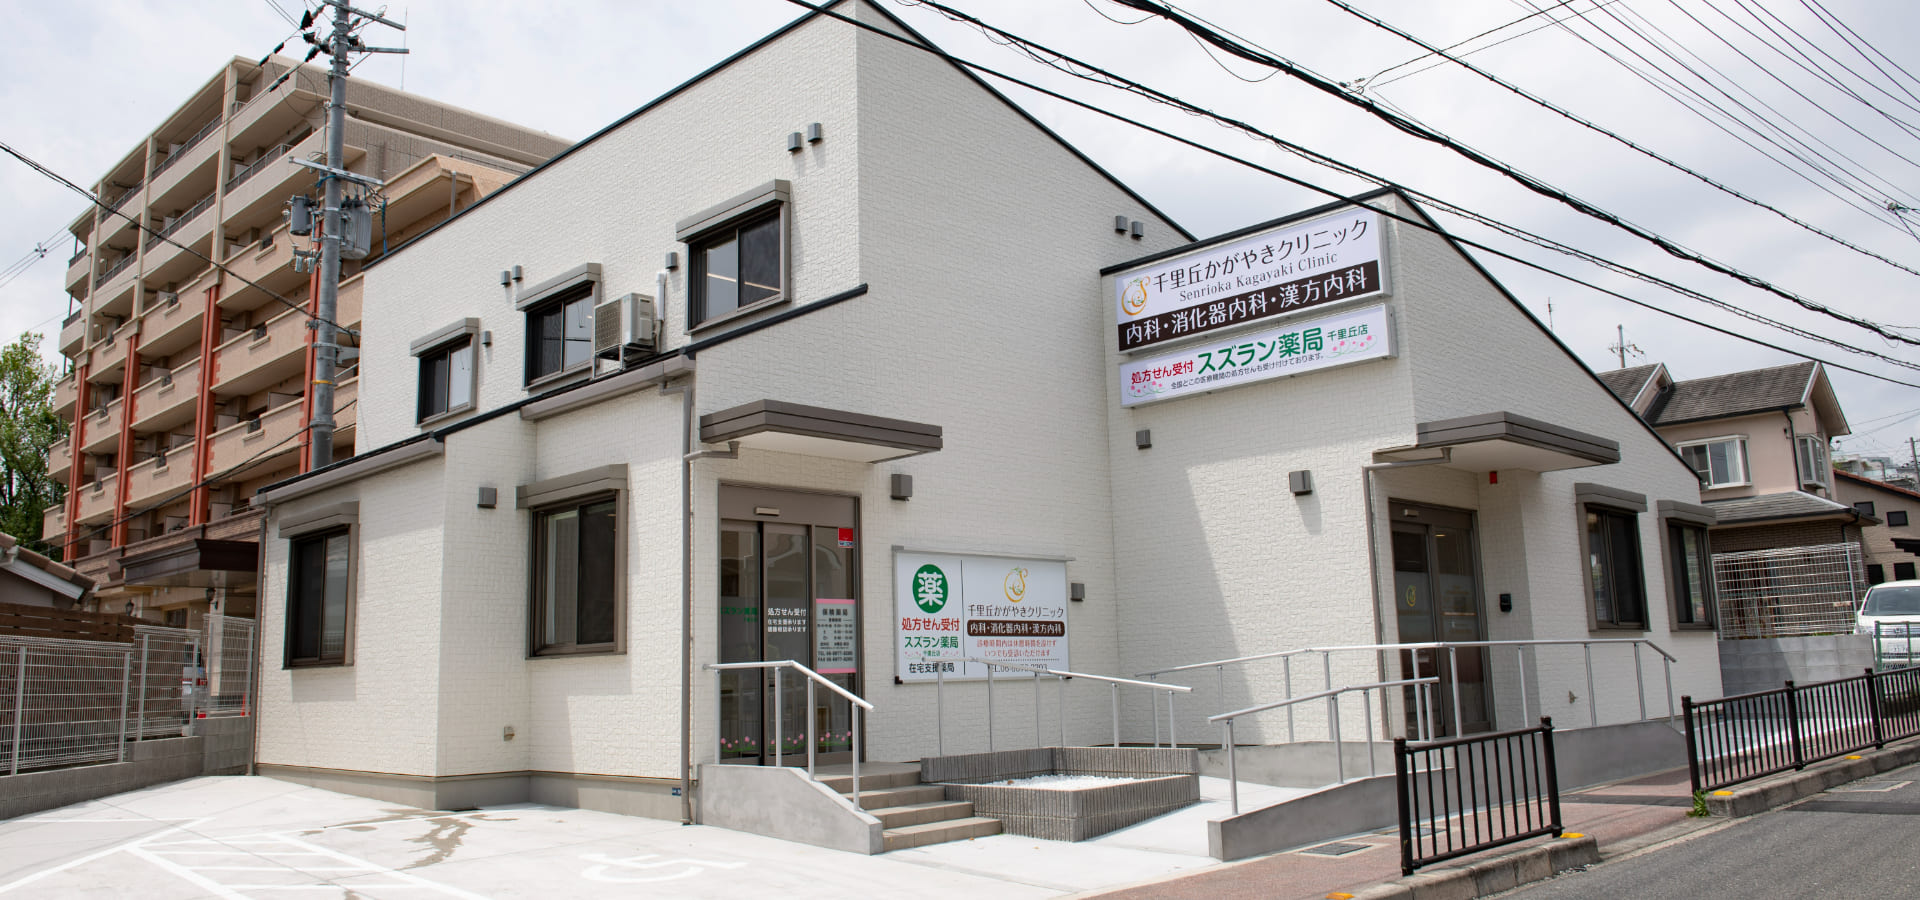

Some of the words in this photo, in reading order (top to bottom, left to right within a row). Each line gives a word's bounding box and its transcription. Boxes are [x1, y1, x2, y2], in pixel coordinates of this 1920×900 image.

[1153, 219, 1367, 293] 千里丘かがやきクリニック
[1180, 279, 1232, 302] Senrioka
[1236, 262, 1293, 288] Kagayaki
[1298, 252, 1338, 272] Clinic
[1126, 265, 1367, 345] 内科・消化器内科・漢方内科
[1131, 360, 1194, 384] 処方せん受付
[1198, 327, 1324, 374] スズラン薬局
[1327, 324, 1368, 341] 千里丘店
[917, 571, 944, 606] 薬
[767, 607, 807, 617] 処方せん受付
[968, 604, 1064, 618] 千里丘かがやきクリニック
[902, 617, 960, 632] 処方せん受付
[970, 622, 1062, 634] 内科・消化器内科・漢方内科
[905, 636, 959, 649] スズラン薬局
